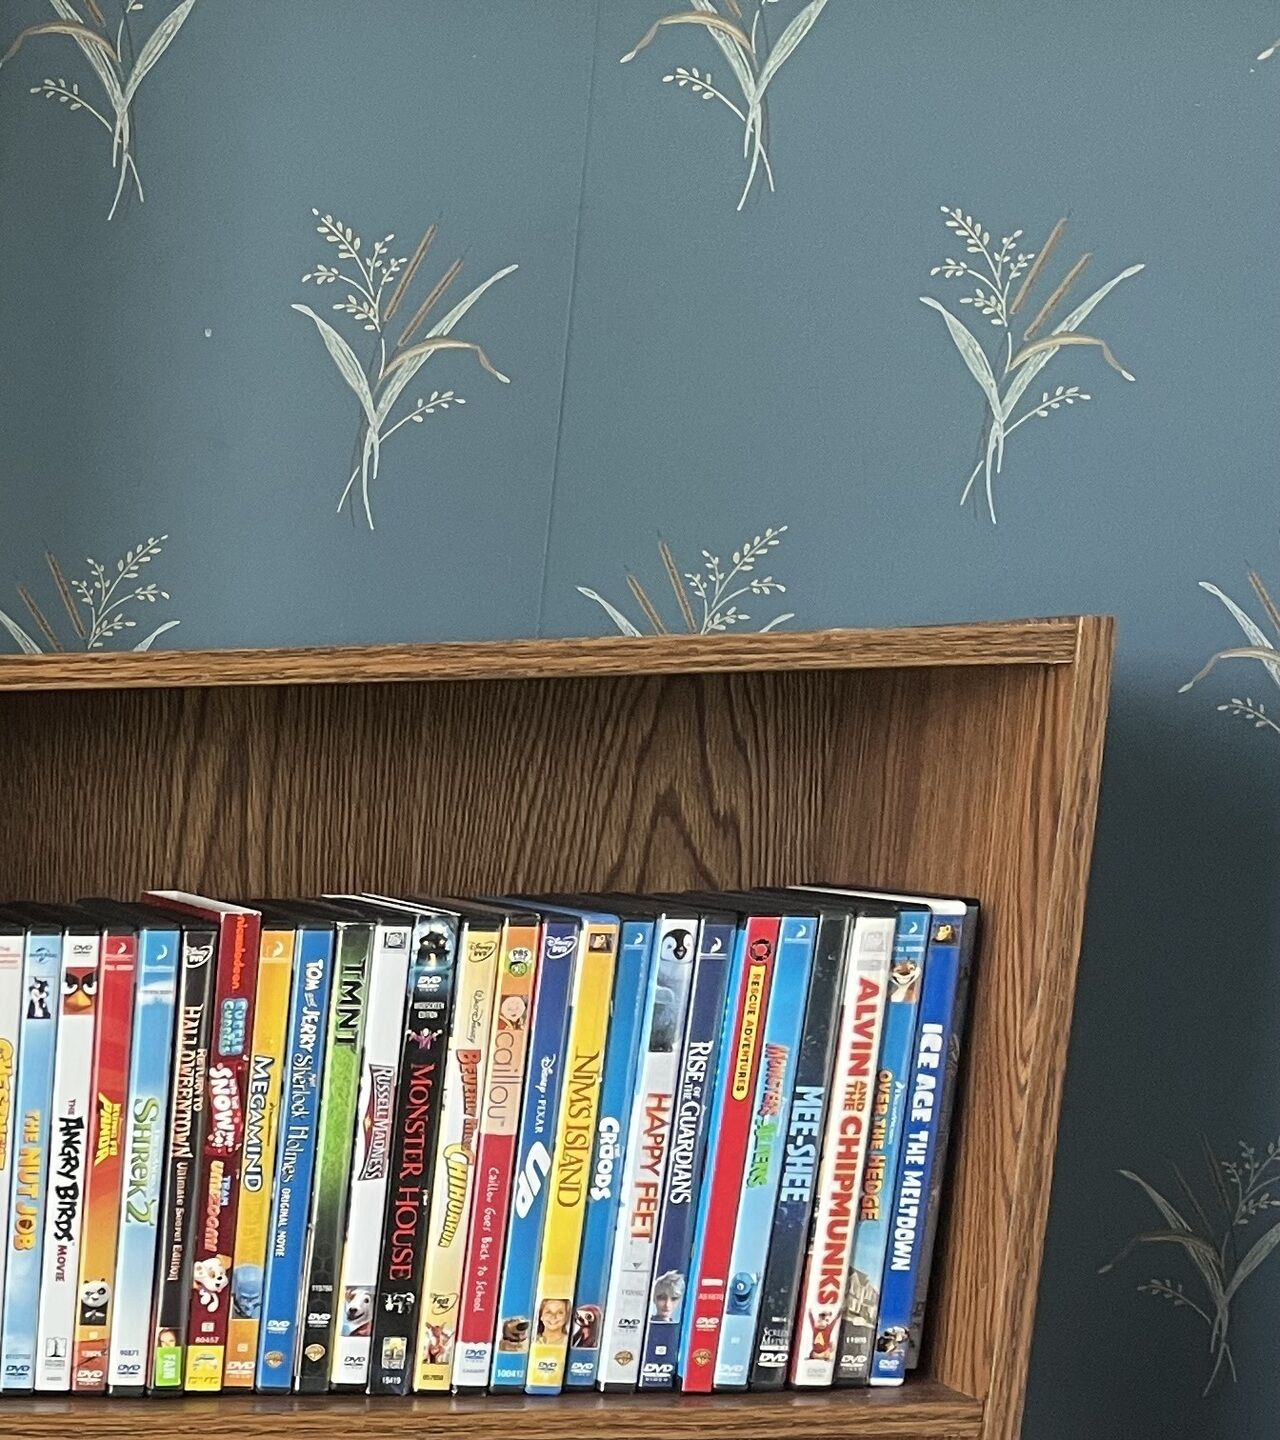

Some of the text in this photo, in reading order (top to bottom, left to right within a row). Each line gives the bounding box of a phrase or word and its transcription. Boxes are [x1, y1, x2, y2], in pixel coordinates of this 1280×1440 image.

[334, 960, 367, 1053] TMNT
[13, 1147, 39, 1251] NUT JOB
[54, 1116, 84, 1281] ANGRY BIRDS MOVIE
[244, 1055, 273, 1192] MEGAMIND
[390, 1063, 436, 1280] MONSTER HOUSE
[556, 1051, 600, 1208] NIM'S ISLAND
[630, 1093, 672, 1244] HAPPY FEET
[780, 1085, 824, 1201] MEE-SHEE
[817, 977, 881, 1305] ALVIN CHIPMUNKS
[890, 1023, 944, 1271] ICE AGE THE MELTDOWN
